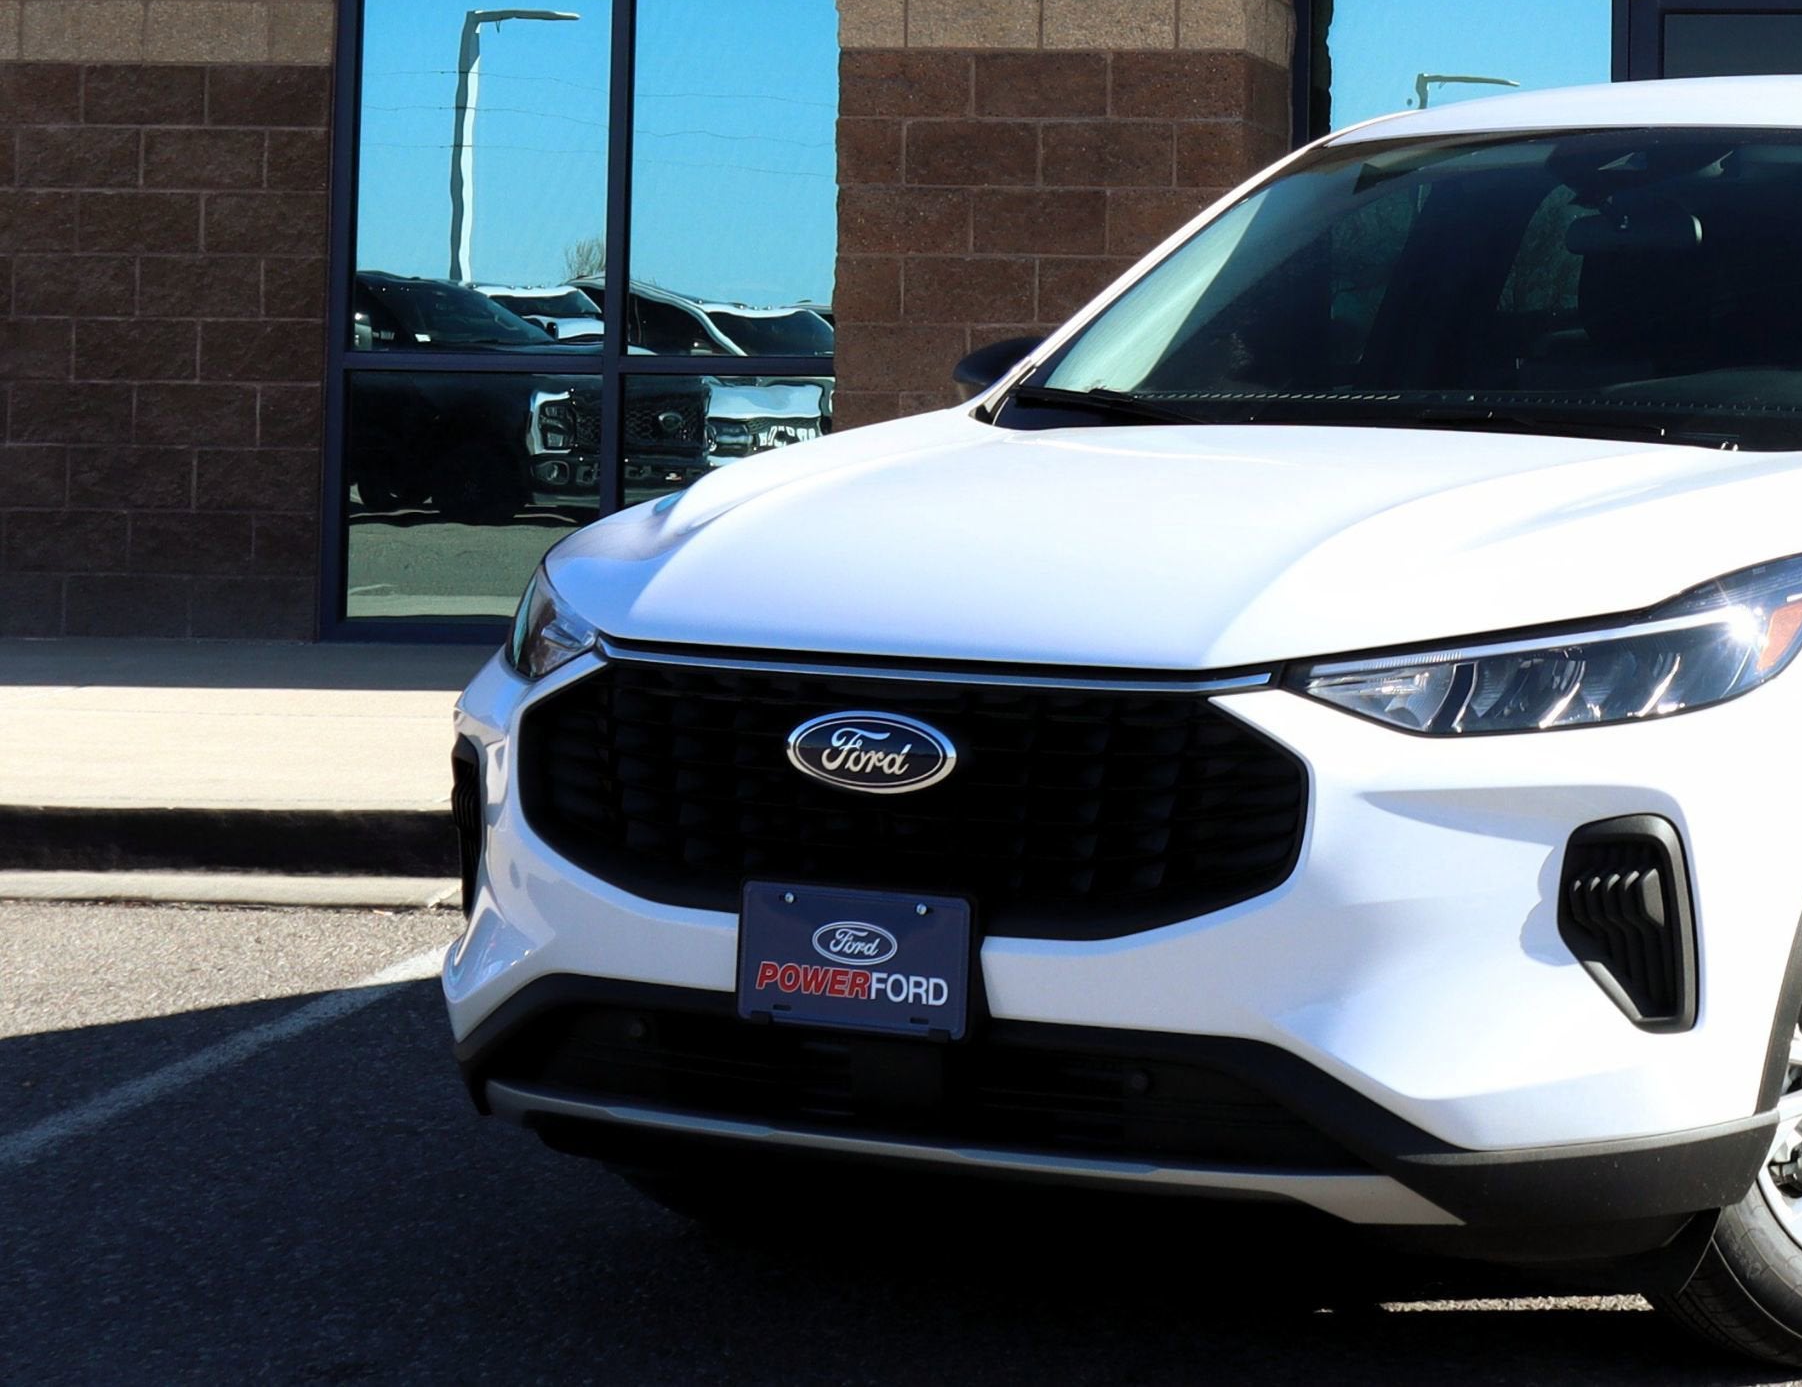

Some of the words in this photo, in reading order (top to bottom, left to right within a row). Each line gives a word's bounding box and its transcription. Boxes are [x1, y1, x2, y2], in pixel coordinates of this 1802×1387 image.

[821, 727, 912, 776] Ford
[829, 928, 880, 957] Ford
[756, 962, 948, 1006] POWERFORD
